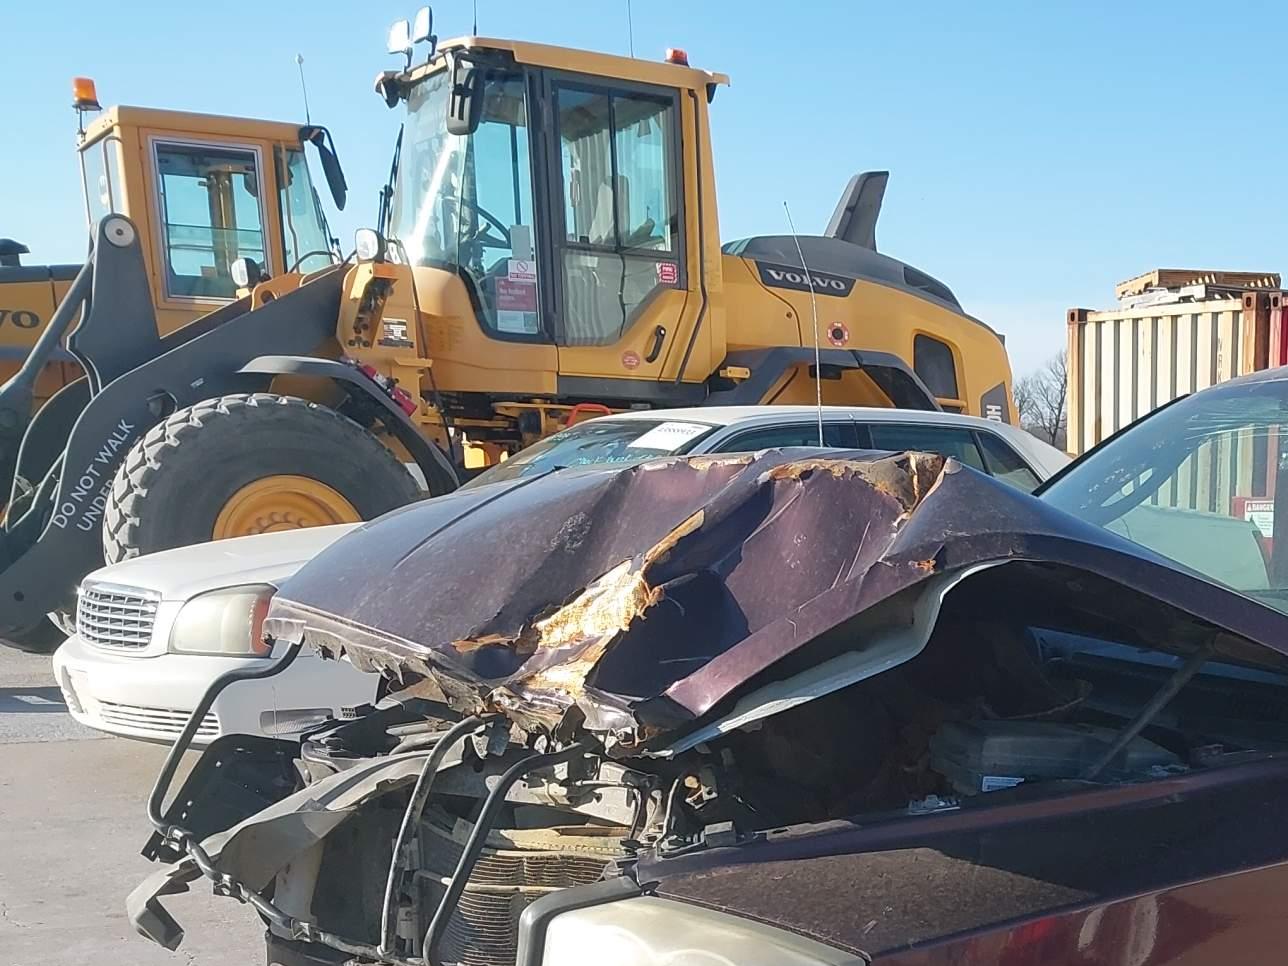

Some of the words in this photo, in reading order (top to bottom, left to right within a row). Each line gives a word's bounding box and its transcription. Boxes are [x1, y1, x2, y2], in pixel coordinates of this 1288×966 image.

[766, 268, 846, 290] VOLVO
[52, 503, 76, 529] DO
[70, 463, 101, 502] NOT
[95, 418, 135, 464] WALK
